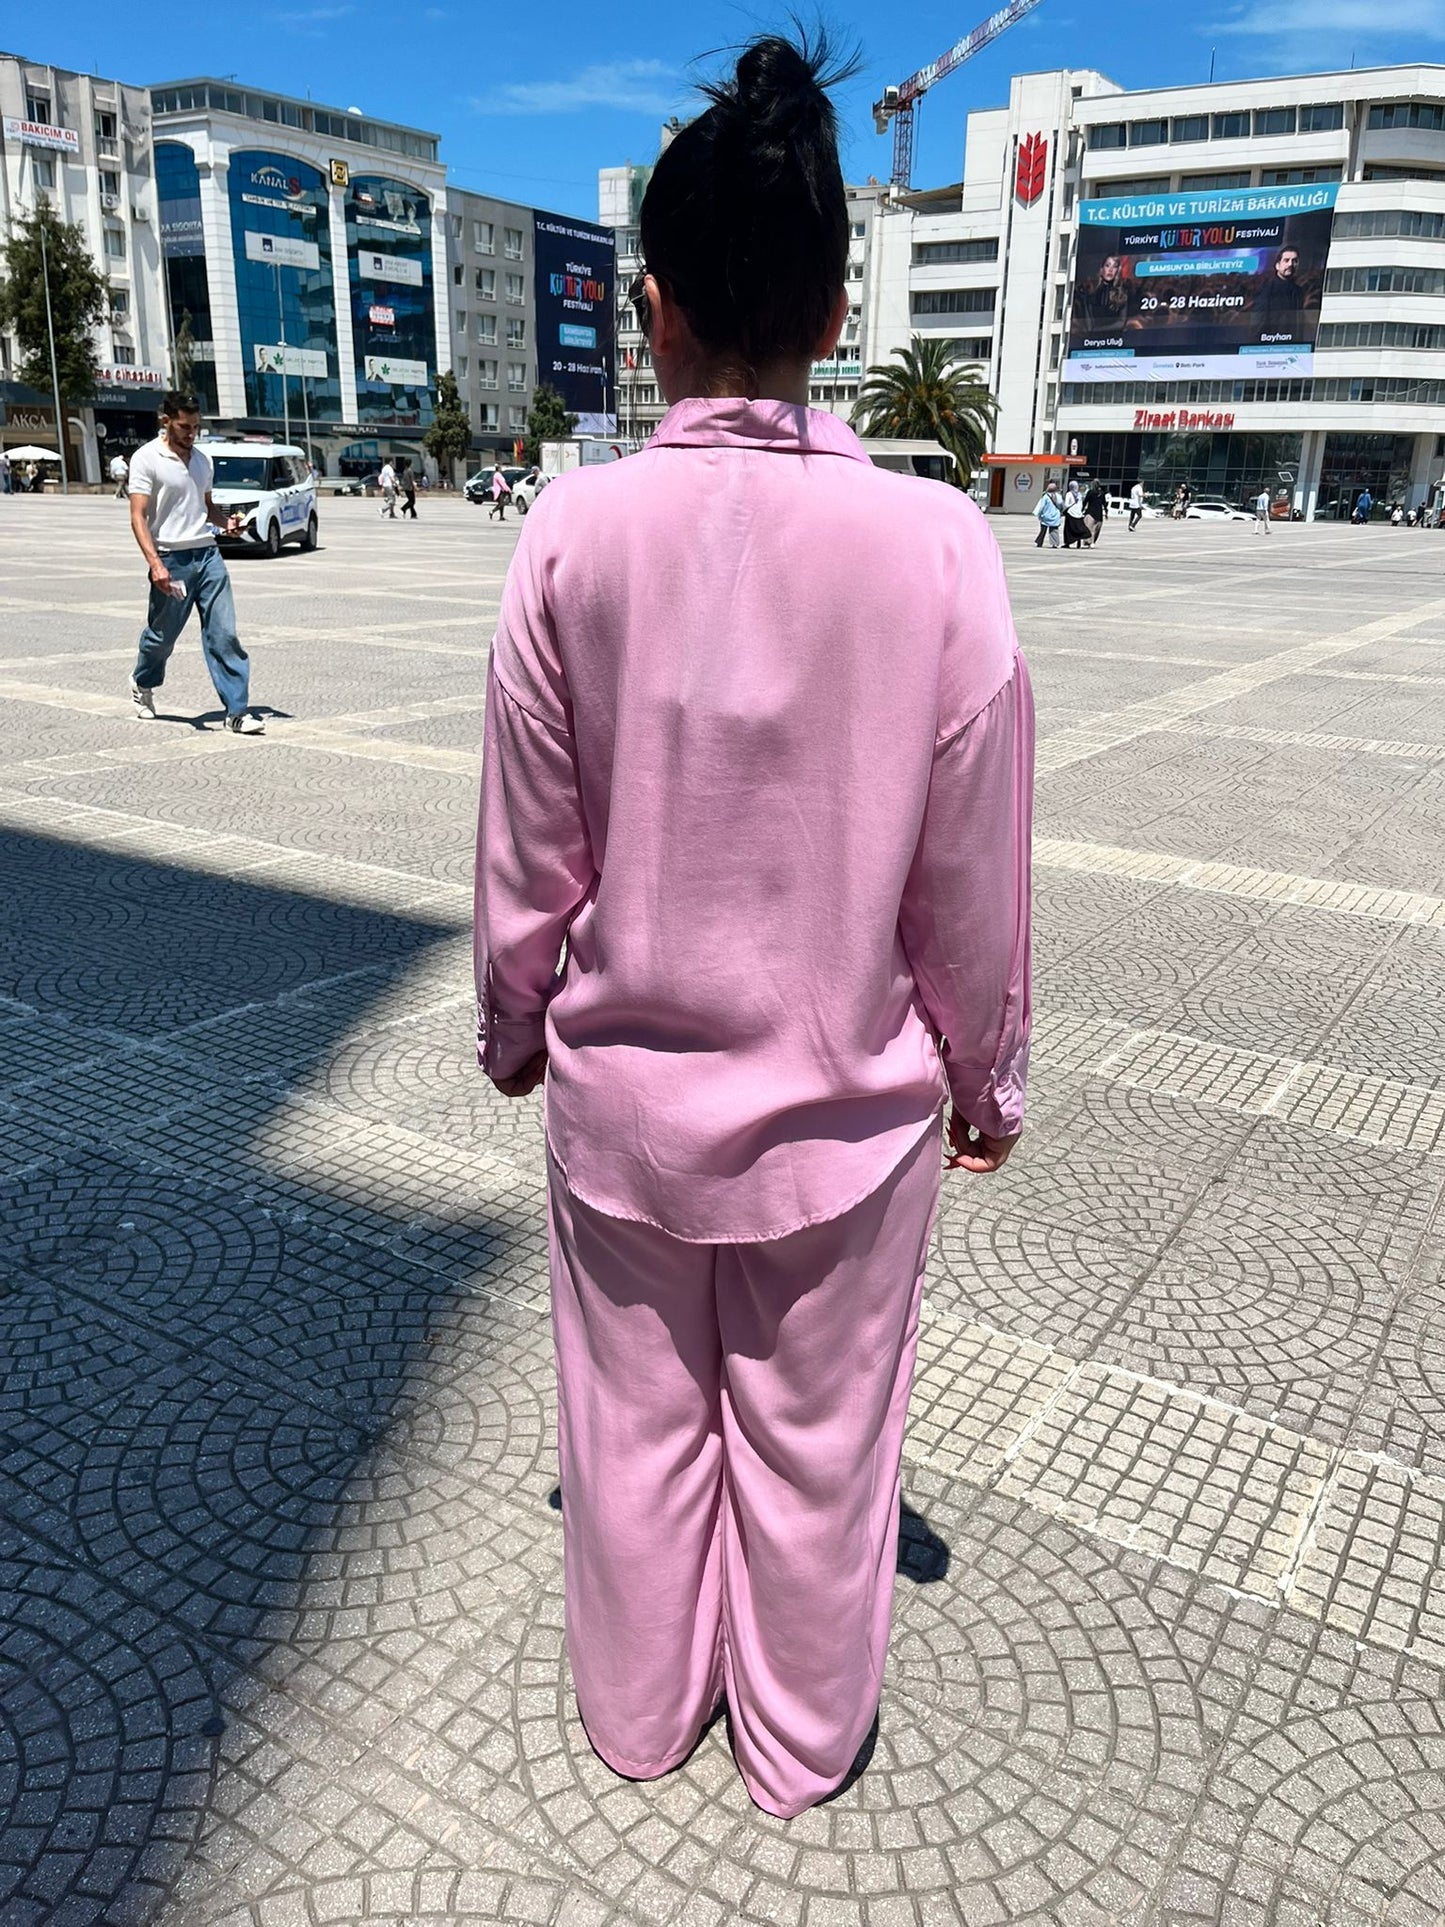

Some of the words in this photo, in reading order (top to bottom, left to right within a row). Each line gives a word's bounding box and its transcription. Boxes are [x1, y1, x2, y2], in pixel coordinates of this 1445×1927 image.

[21, 122, 61, 138] BAKICIM
[65, 131, 77, 141] OL
[251, 172, 288, 189] KANAL
[1088, 208, 1110, 221] T.C.
[1113, 202, 1165, 219] KÜLTÜR
[1169, 203, 1186, 216] VE
[1191, 196, 1244, 214] TURİZM
[1247, 190, 1329, 210] BAKANLIĞI
[1125, 234, 1159, 245] TÜRKİYE
[1160, 229, 1201, 248] KÜLTÜR
[1202, 226, 1236, 246] YOLU
[1236, 226, 1280, 238] FESTİVALİ
[1140, 298, 1158, 310] 20
[1170, 296, 1186, 308] 28
[1188, 294, 1244, 307] Haziran
[1084, 338, 1105, 347] Derya
[1261, 333, 1292, 343] Bayhan
[553, 361, 563, 371] 20
[567, 362, 577, 372] 28
[12, 413, 48, 430] AKÇA
[1134, 410, 1176, 427] Ziraat
[1178, 410, 1236, 427] Bankası
